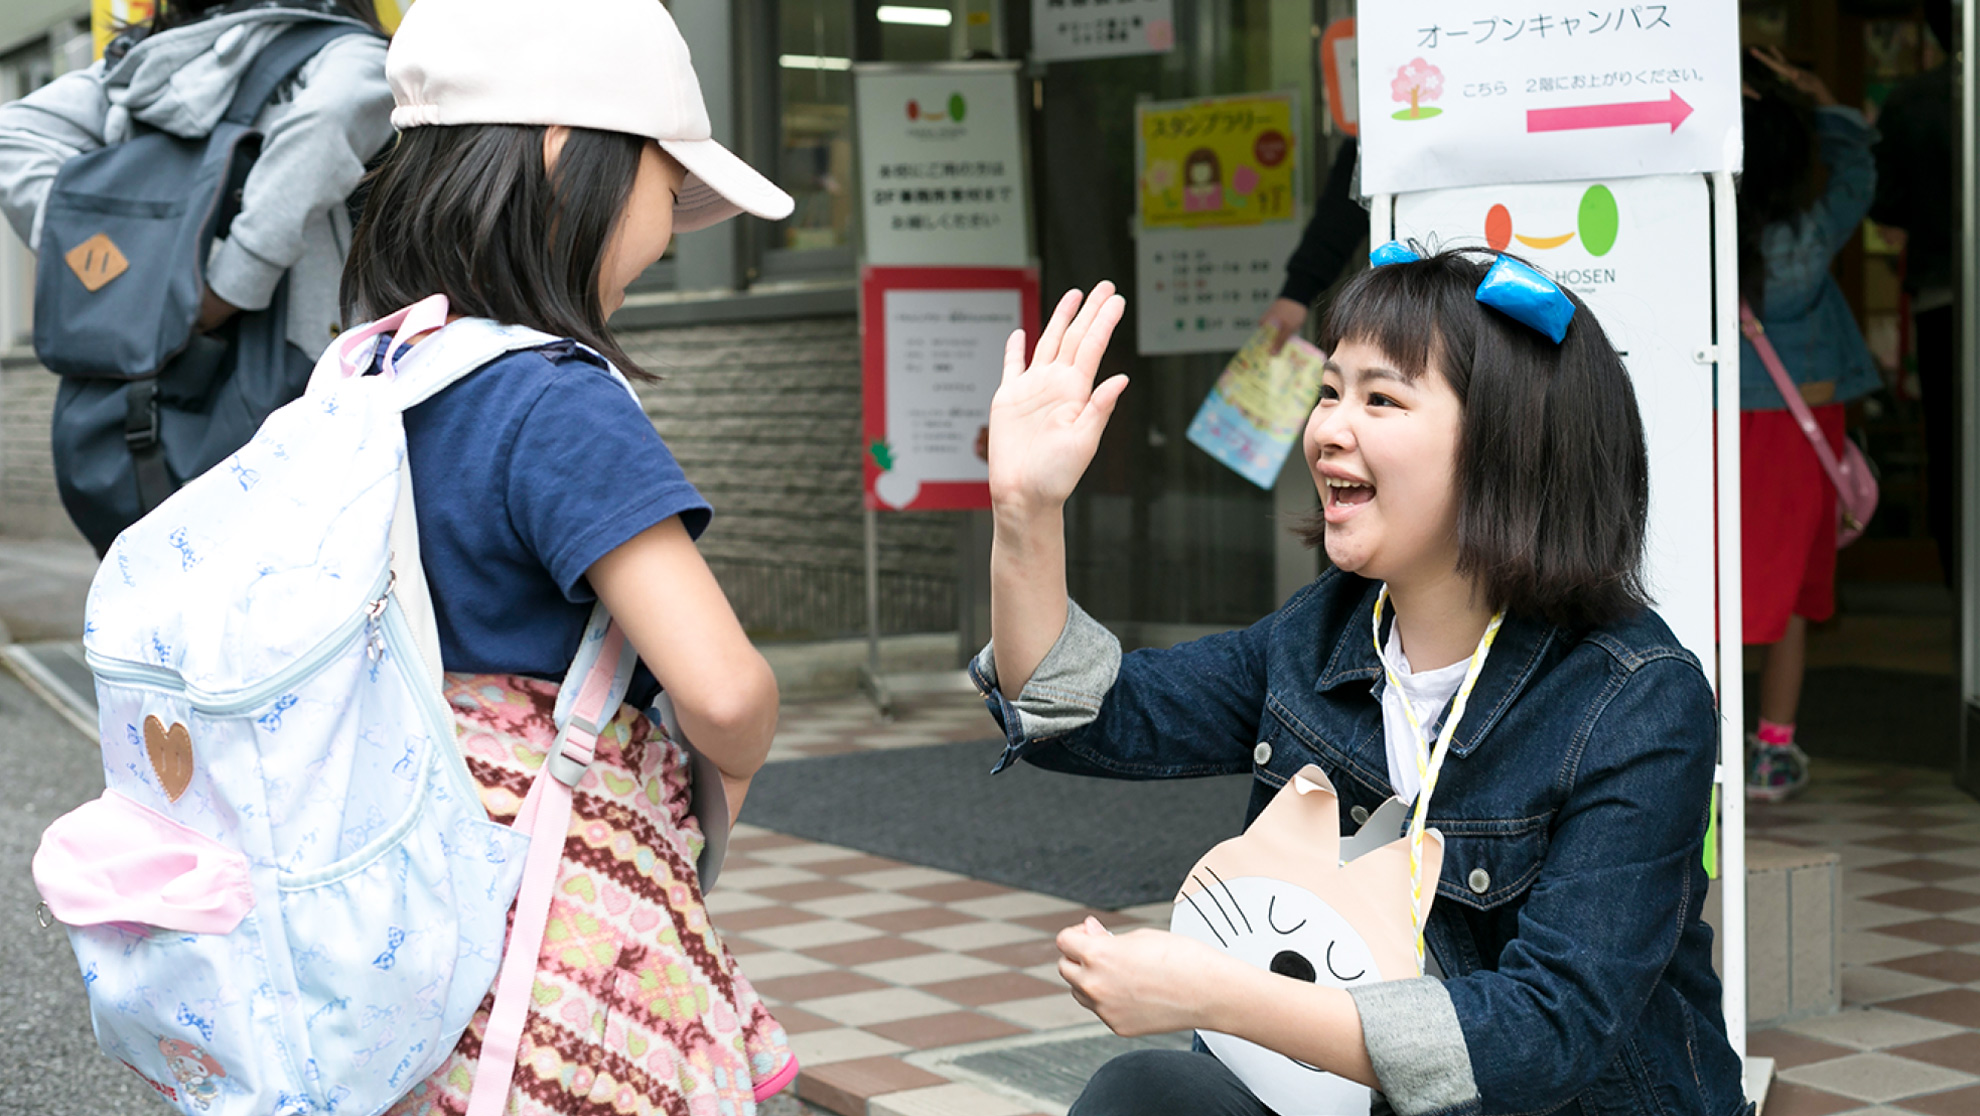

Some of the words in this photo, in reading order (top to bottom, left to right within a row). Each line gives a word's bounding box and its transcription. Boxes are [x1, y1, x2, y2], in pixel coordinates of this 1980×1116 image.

[1417, 4, 1671, 49] オープンキャンパス
[1463, 81, 1508, 98] こちら
[1525, 68, 1704, 94] 2階にお上がりください。
[1149, 108, 1274, 139] スタンプラリー
[1555, 268, 1616, 285] HOSEN
